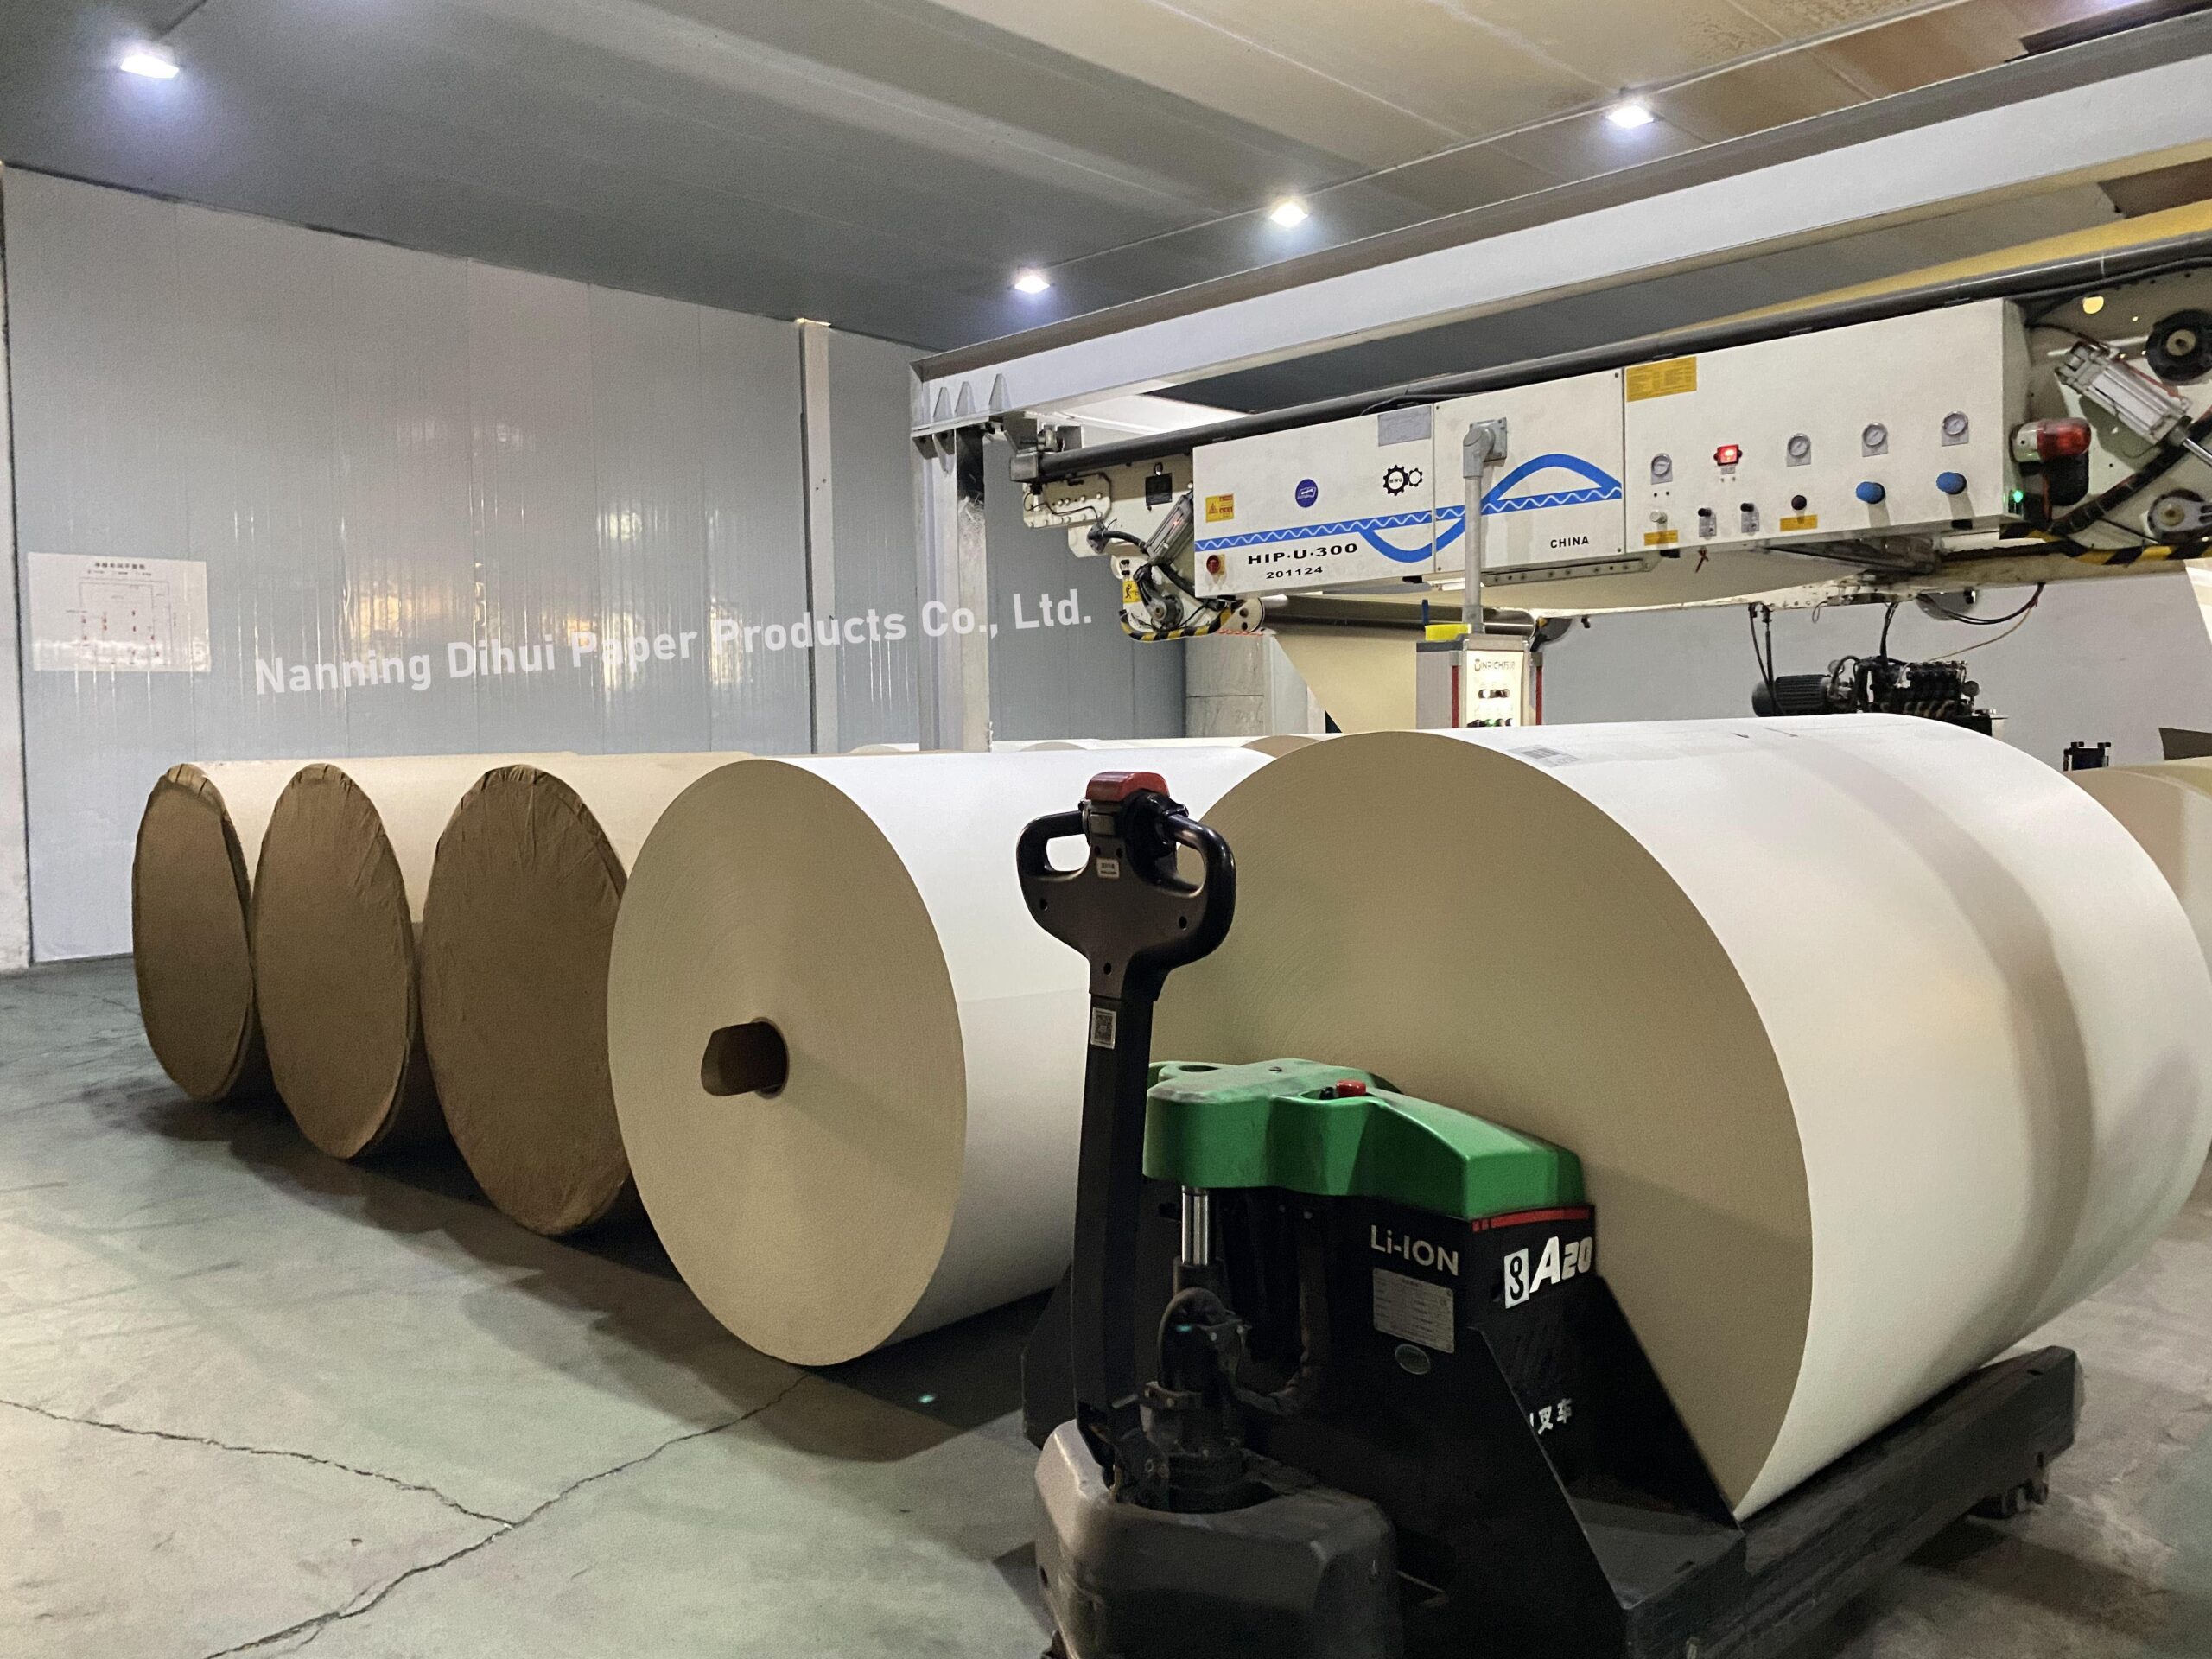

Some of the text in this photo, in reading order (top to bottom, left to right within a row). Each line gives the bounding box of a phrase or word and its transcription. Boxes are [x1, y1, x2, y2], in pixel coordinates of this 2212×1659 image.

[1550, 536, 1589, 549] CHINA
[1265, 566, 1323, 579] 201124
[1370, 1224, 1459, 1276] Li-ION
[1529, 1398, 1573, 1434] 叉车
